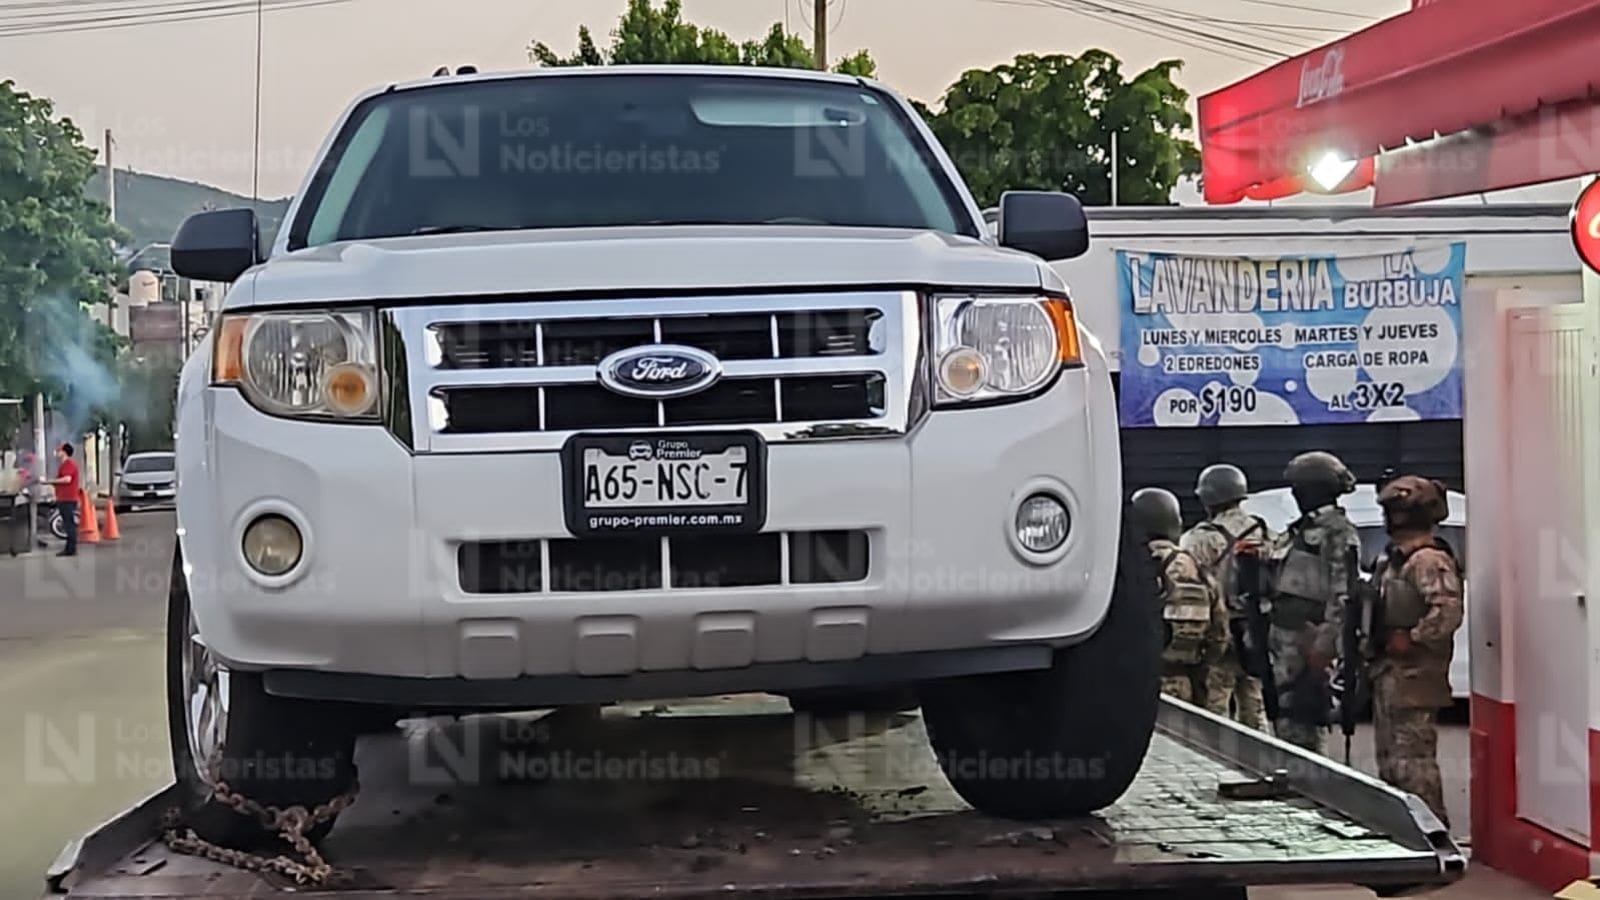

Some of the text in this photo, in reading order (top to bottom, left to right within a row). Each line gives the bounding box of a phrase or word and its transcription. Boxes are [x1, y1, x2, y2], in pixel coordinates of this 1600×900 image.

[1384, 253, 1416, 279] LA
[1130, 256, 1335, 314] LAVANDERIA
[1343, 278, 1457, 309] BURBUJA
[1143, 329, 1282, 345] LUNES Y MIERCOLES
[1294, 324, 1438, 342] MARTES Y JUEVES
[632, 357, 687, 381] Ford
[1166, 356, 1260, 371] 2 EDREDONES
[1305, 351, 1429, 368] CARGA DE ROPA
[1170, 387, 1256, 413] POR $190
[1331, 382, 1405, 408] AL 3X2
[656, 449, 701, 459] Premier
[658, 440, 689, 449] Grupo
[586, 463, 747, 501] A65-NSC-7
[589, 514, 743, 529] grupo-premier.com.mx
